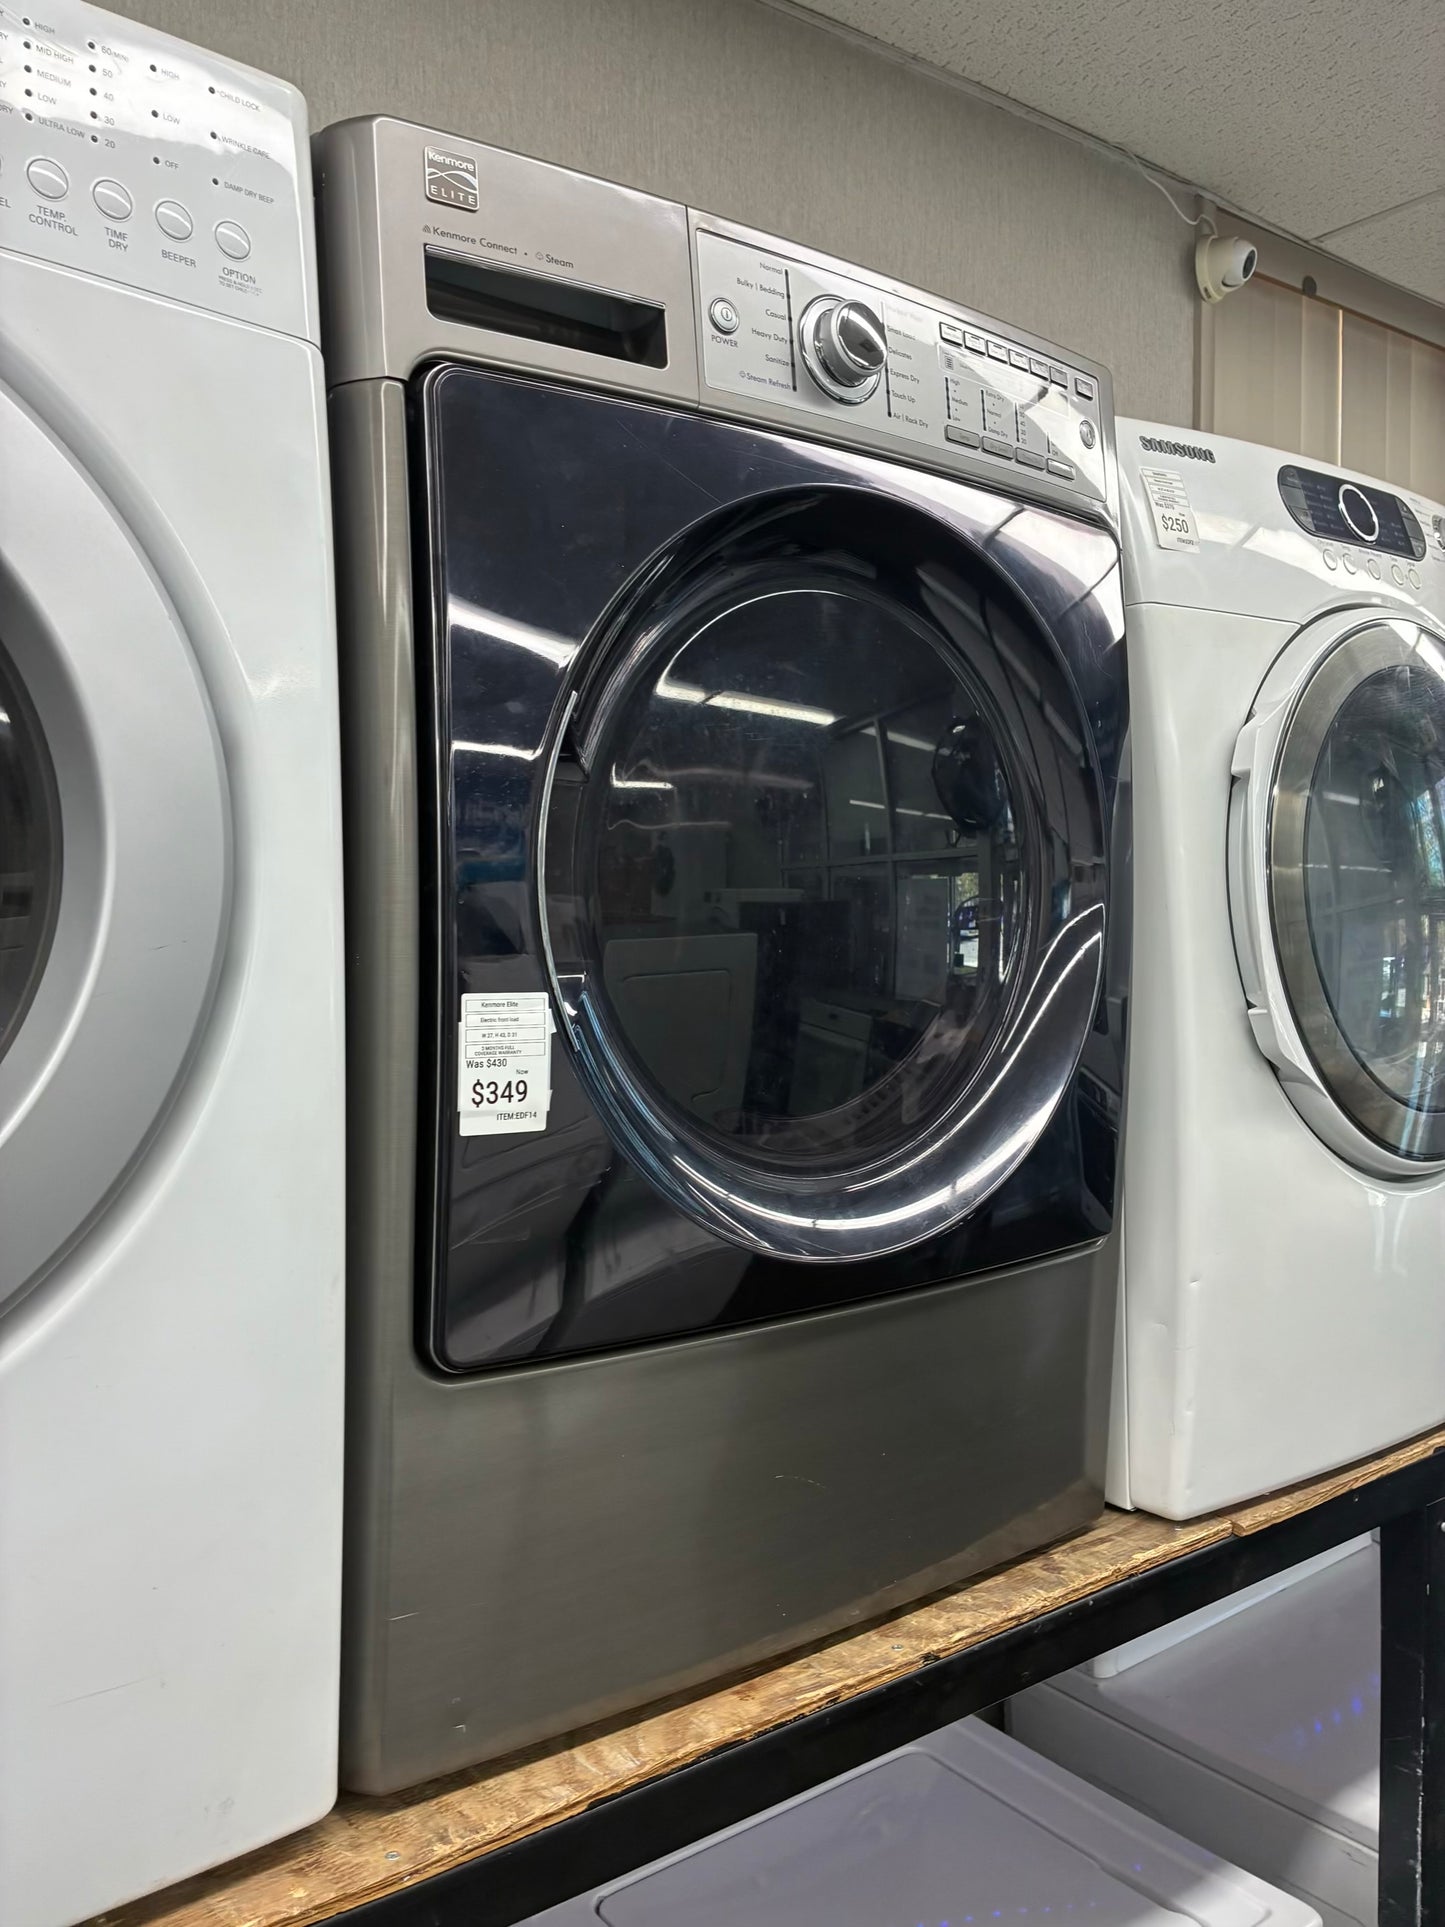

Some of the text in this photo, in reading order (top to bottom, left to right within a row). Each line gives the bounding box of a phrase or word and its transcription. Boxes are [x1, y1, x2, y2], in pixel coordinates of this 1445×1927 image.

[34, 22, 55, 34] HIGH
[35, 44, 74, 64] MID HIGH
[101, 45, 112, 56] 60
[36, 69, 72, 87] MEDIUM
[102, 68, 113, 78] 50
[161, 68, 180, 80] HIGH
[37, 92, 57, 105] LOW
[104, 92, 114, 102] 40
[104, 115, 115, 126] 30
[162, 112, 181, 125] LOW
[38, 117, 86, 139] ULTRA LOW
[104, 138, 116, 149] 20
[221, 136, 251, 152] WRINKLE
[164, 160, 179, 170] OFF
[428, 151, 475, 172] Kenmore
[224, 181, 275, 204] DAMP DRY BEEP
[430, 184, 476, 205] ELITE
[36, 205, 67, 222] TEMP.
[28, 213, 79, 237] CONTROL
[104, 227, 128, 242] TIME
[108, 238, 129, 252] DRY
[432, 226, 574, 269] Kenmore Connect Steam
[161, 249, 197, 268] BEEPER
[222, 266, 256, 285] OPTION
[759, 262, 783, 275] Normal
[736, 277, 754, 290] Bulky
[759, 284, 785, 300] Bedding
[765, 309, 786, 321] Casual
[711, 334, 738, 348] POWER
[751, 327, 788, 345] Heavy Duty
[764, 353, 790, 367] Sanitize
[888, 346, 912, 360] Delicates
[746, 372, 792, 391] Steam Refresh
[890, 368, 920, 384] Express Dry
[891, 389, 917, 404] Touch Up
[892, 411, 901, 421] Air
[905, 415, 918, 426] Rack
[918, 418, 929, 430] Dry
[1139, 435, 1216, 464] SAMSUNG
[1161, 513, 1189, 534] $250
[465, 1058, 508, 1068] Was $430
[471, 1078, 528, 1108] $349
[496, 1111, 537, 1121] ITEM:EDF14
